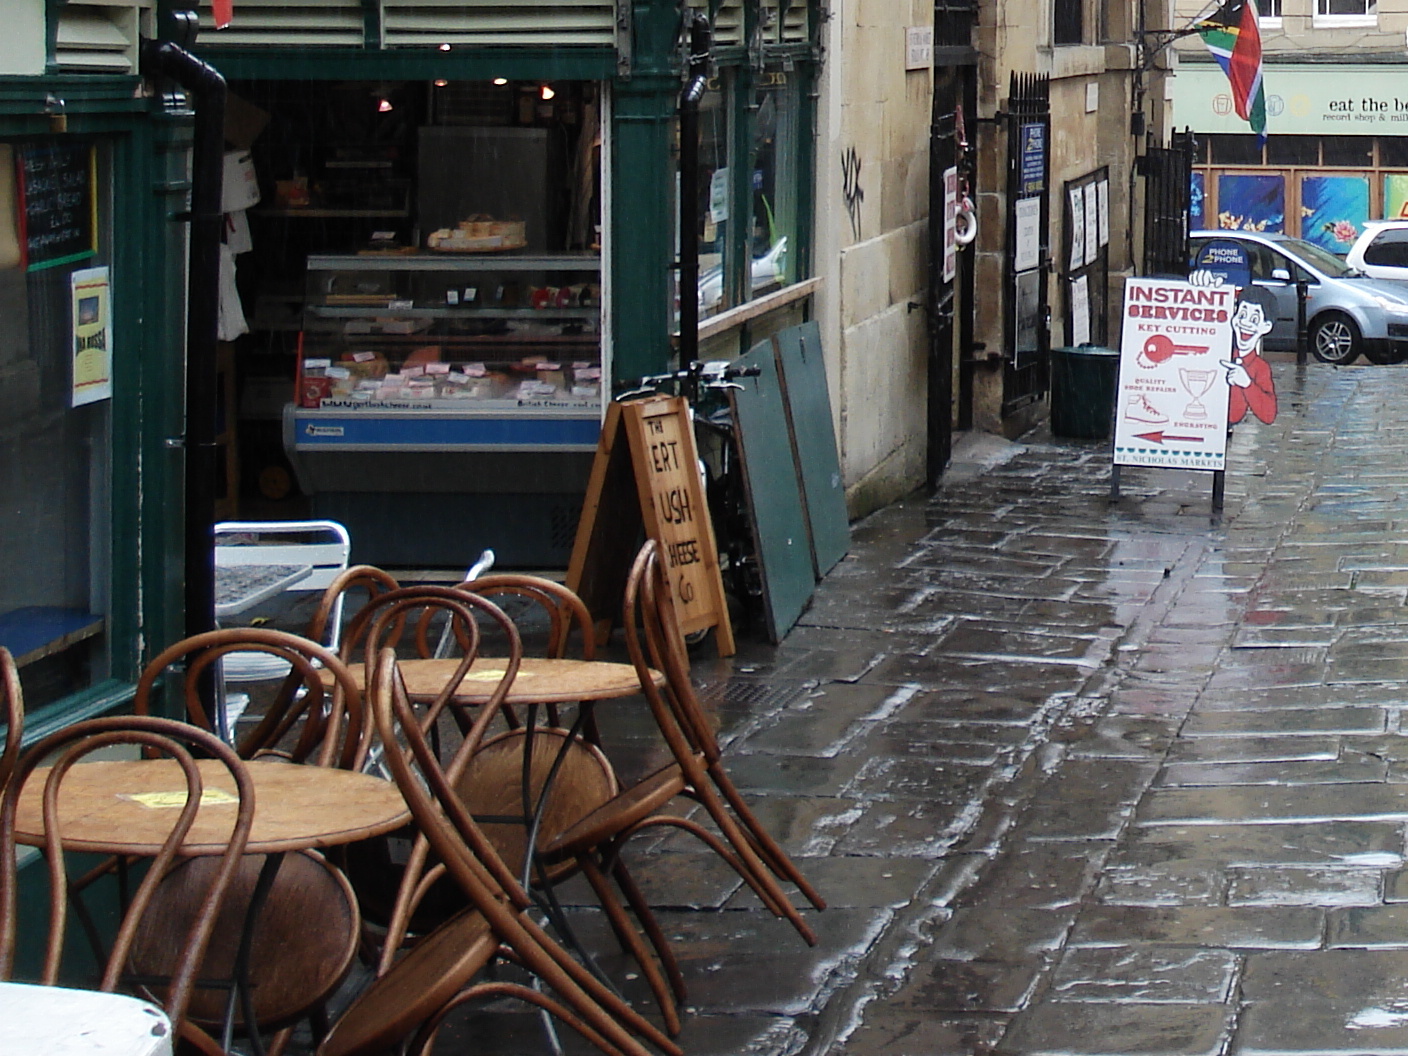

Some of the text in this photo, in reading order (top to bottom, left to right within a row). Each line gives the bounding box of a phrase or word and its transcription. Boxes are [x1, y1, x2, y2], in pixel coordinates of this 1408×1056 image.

[1329, 97, 1354, 112] eat
[1362, 97, 1388, 112] the
[1322, 113, 1351, 121] record
[1354, 113, 1376, 123] shop
[1378, 113, 1386, 122] &
[1209, 248, 1238, 256] PHONE
[1128, 285, 1230, 307] INSTANT
[1128, 304, 1228, 323] SERVICES
[1138, 323, 1216, 336] KEY CUTTING
[1135, 377, 1166, 385] QUALITY
[647, 420, 664, 436] THE
[1173, 421, 1218, 430] ENGRAVING
[650, 441, 679, 473] ERT
[1132, 455, 1178, 464] NICHOLAS
[1180, 457, 1223, 468] MARKETS
[660, 487, 693, 525] USH
[668, 539, 700, 569] HEESE
